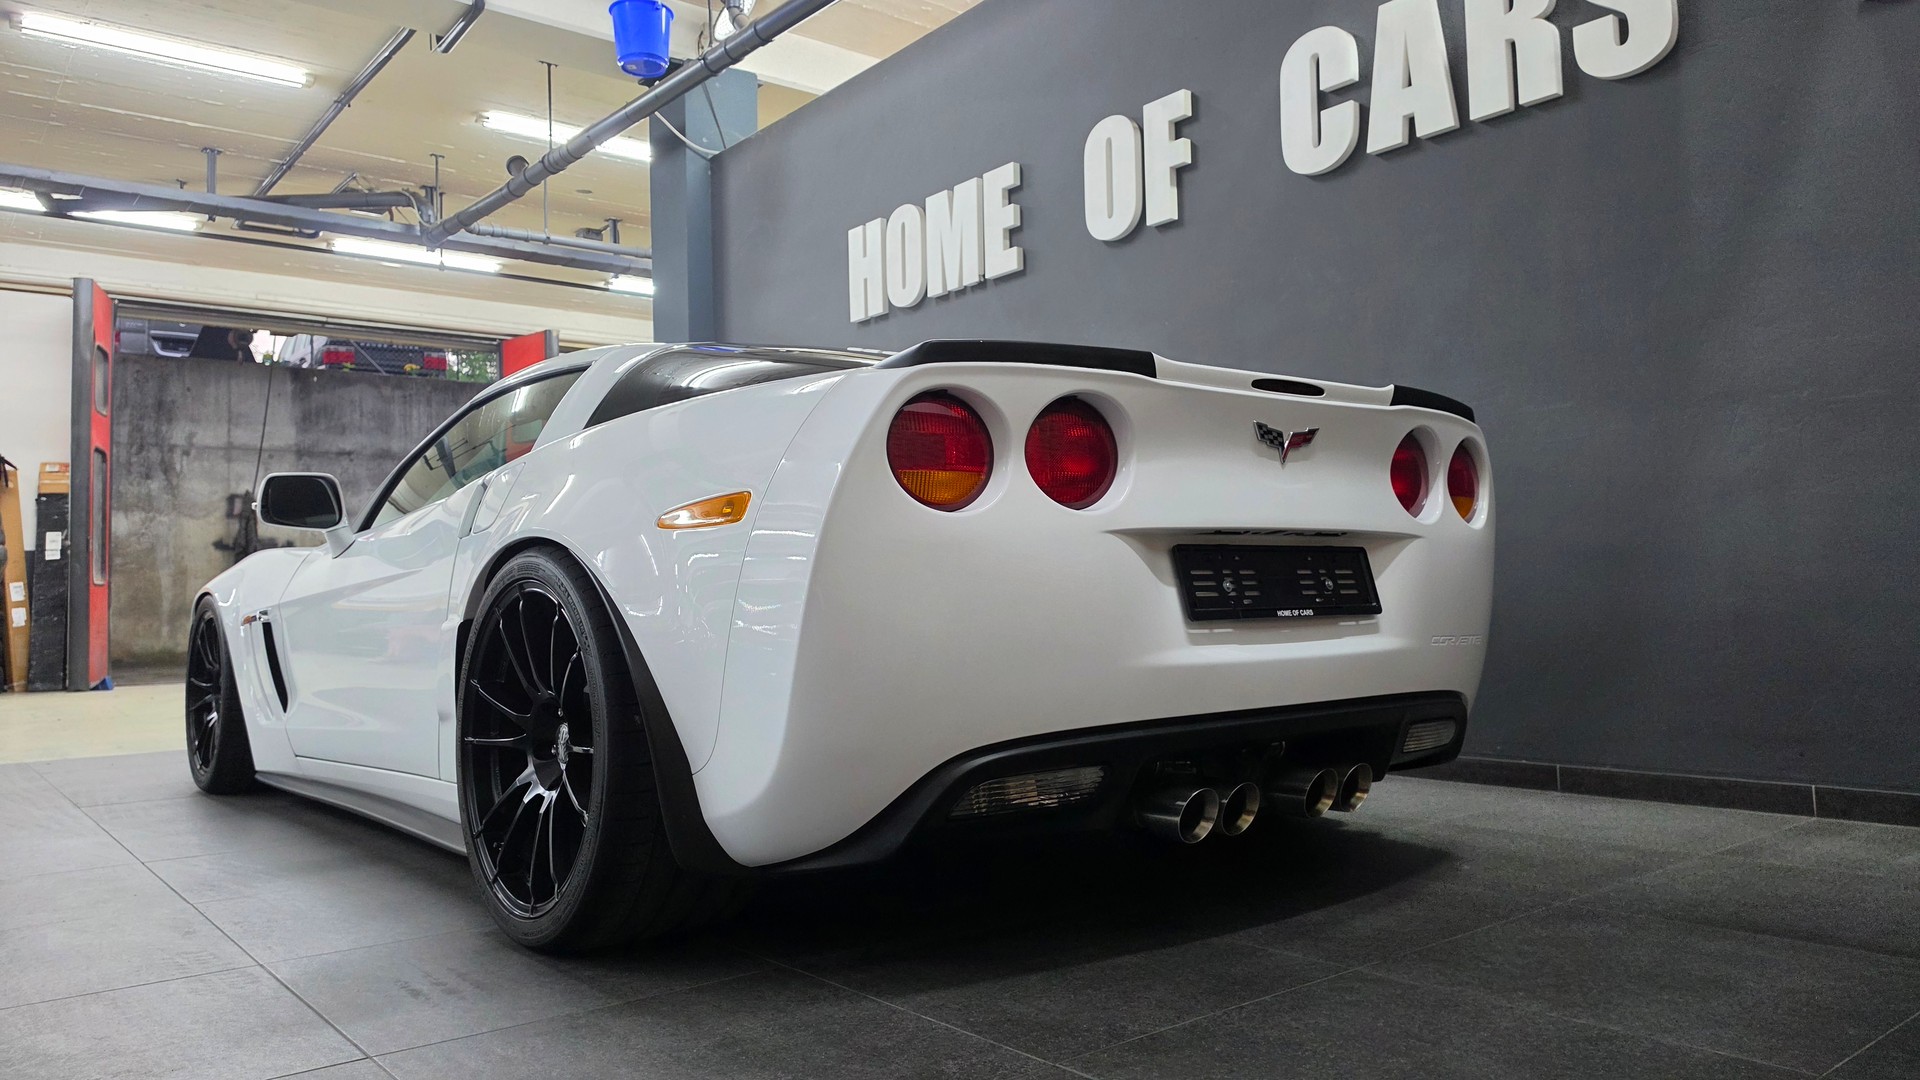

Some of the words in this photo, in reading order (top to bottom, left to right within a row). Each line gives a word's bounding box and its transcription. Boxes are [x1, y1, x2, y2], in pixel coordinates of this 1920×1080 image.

[848, 162, 1023, 322] HOME
[1083, 88, 1193, 241] OF
[1431, 634, 1483, 646] CORVETTE
